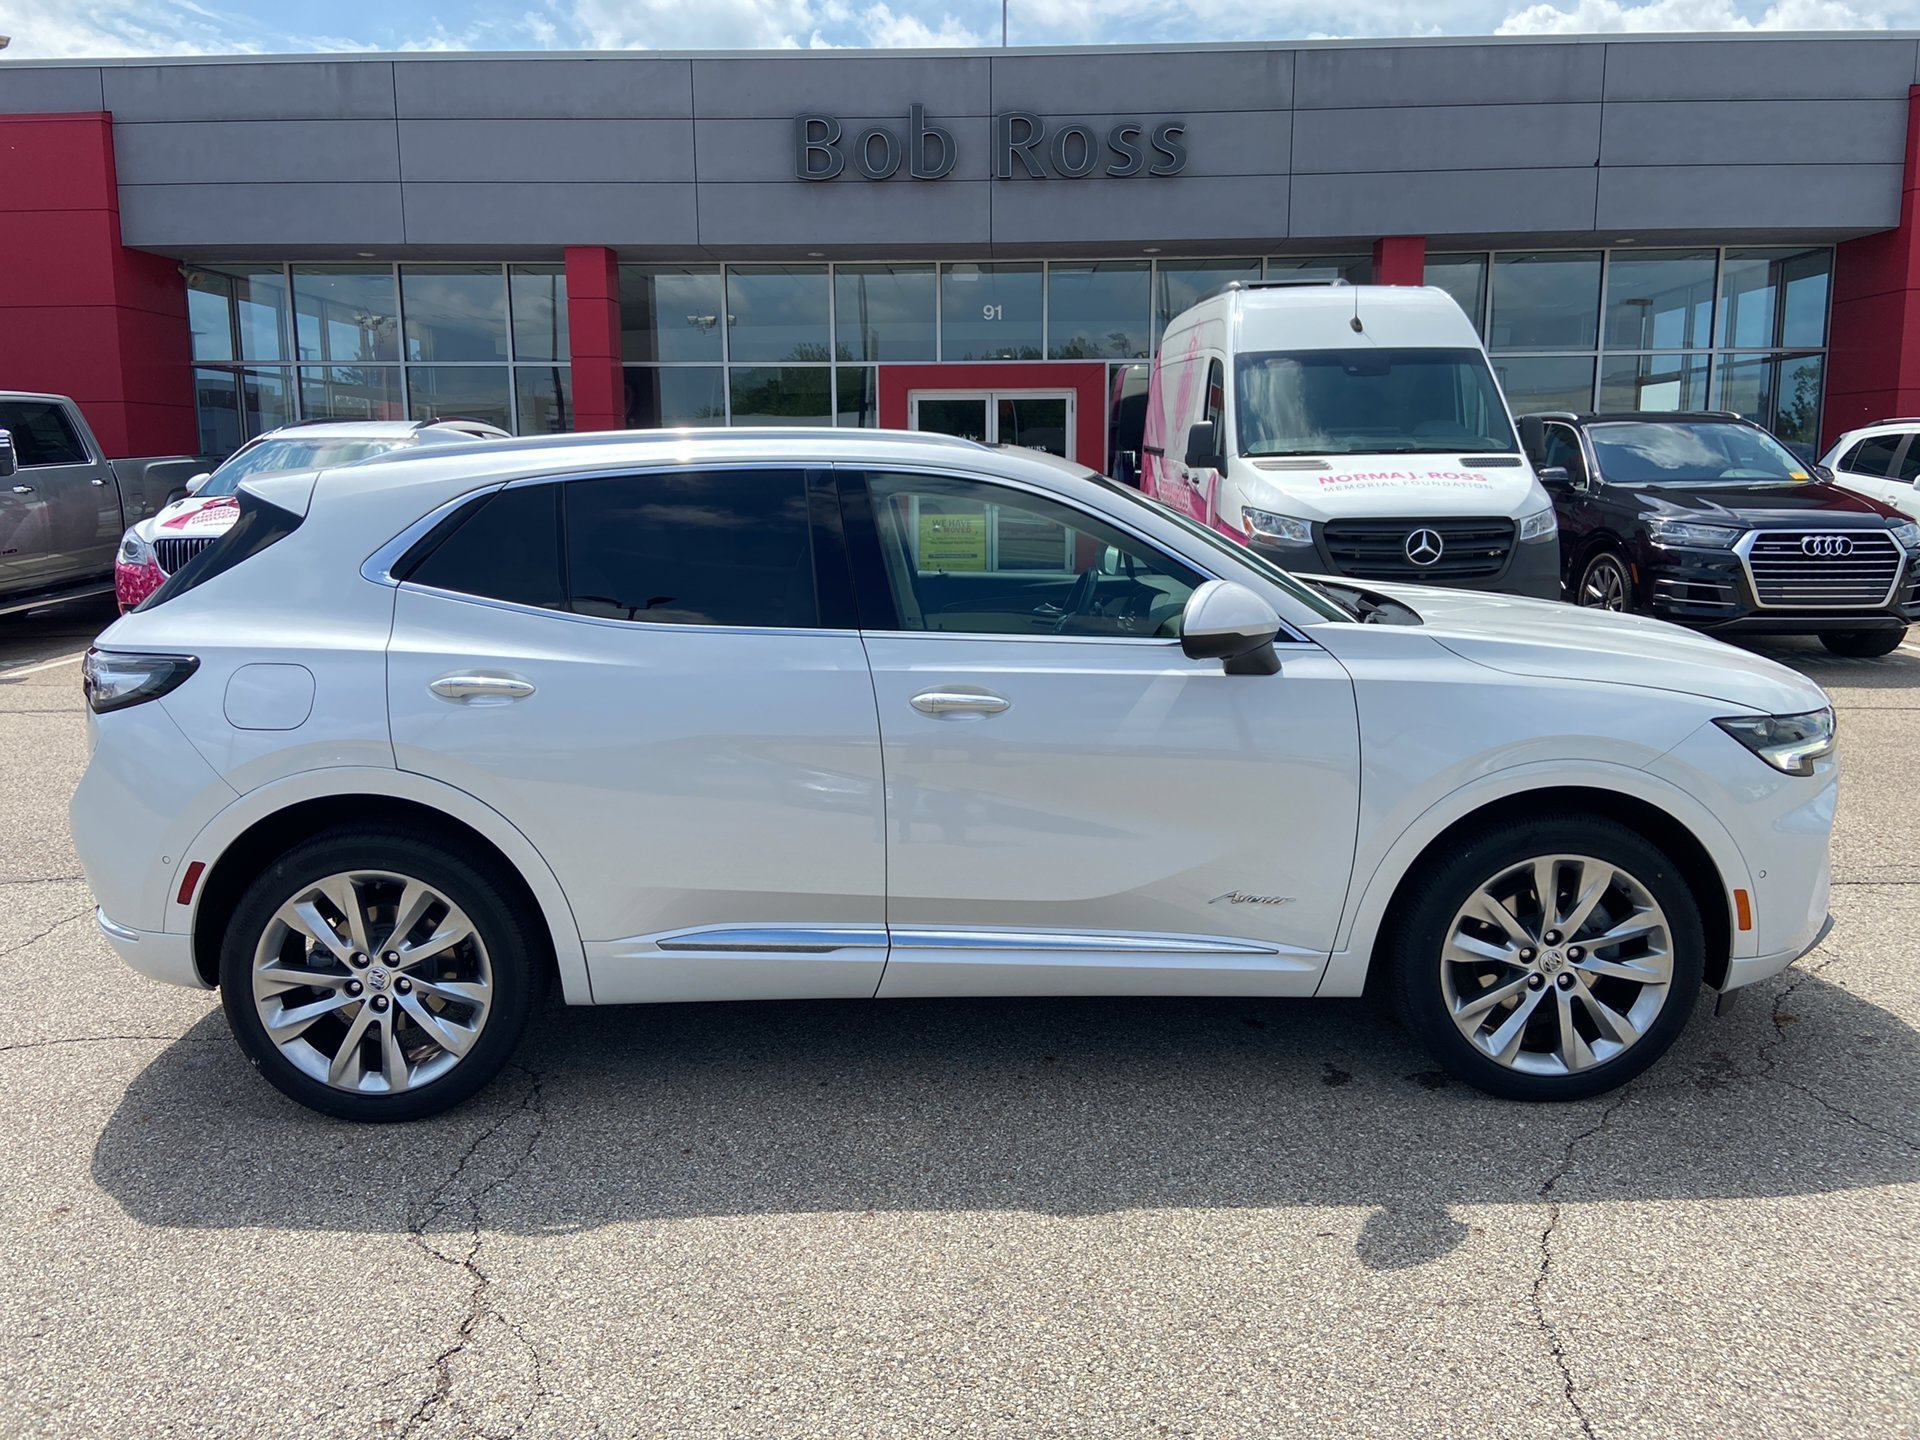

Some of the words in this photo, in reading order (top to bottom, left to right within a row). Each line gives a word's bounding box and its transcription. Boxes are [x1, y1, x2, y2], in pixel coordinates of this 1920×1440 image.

[793, 103, 959, 181] Bob
[996, 111, 1189, 179] Ross
[983, 304, 1002, 321] 91
[1318, 472, 1405, 484] NORMA
[1408, 472, 1424, 480] J.
[1427, 472, 1488, 481] ROSS
[1324, 481, 1397, 492] MEMORIAL
[1402, 481, 1494, 490] FOUNDATION
[932, 519, 947, 528] WE
[948, 519, 971, 528] HAVE
